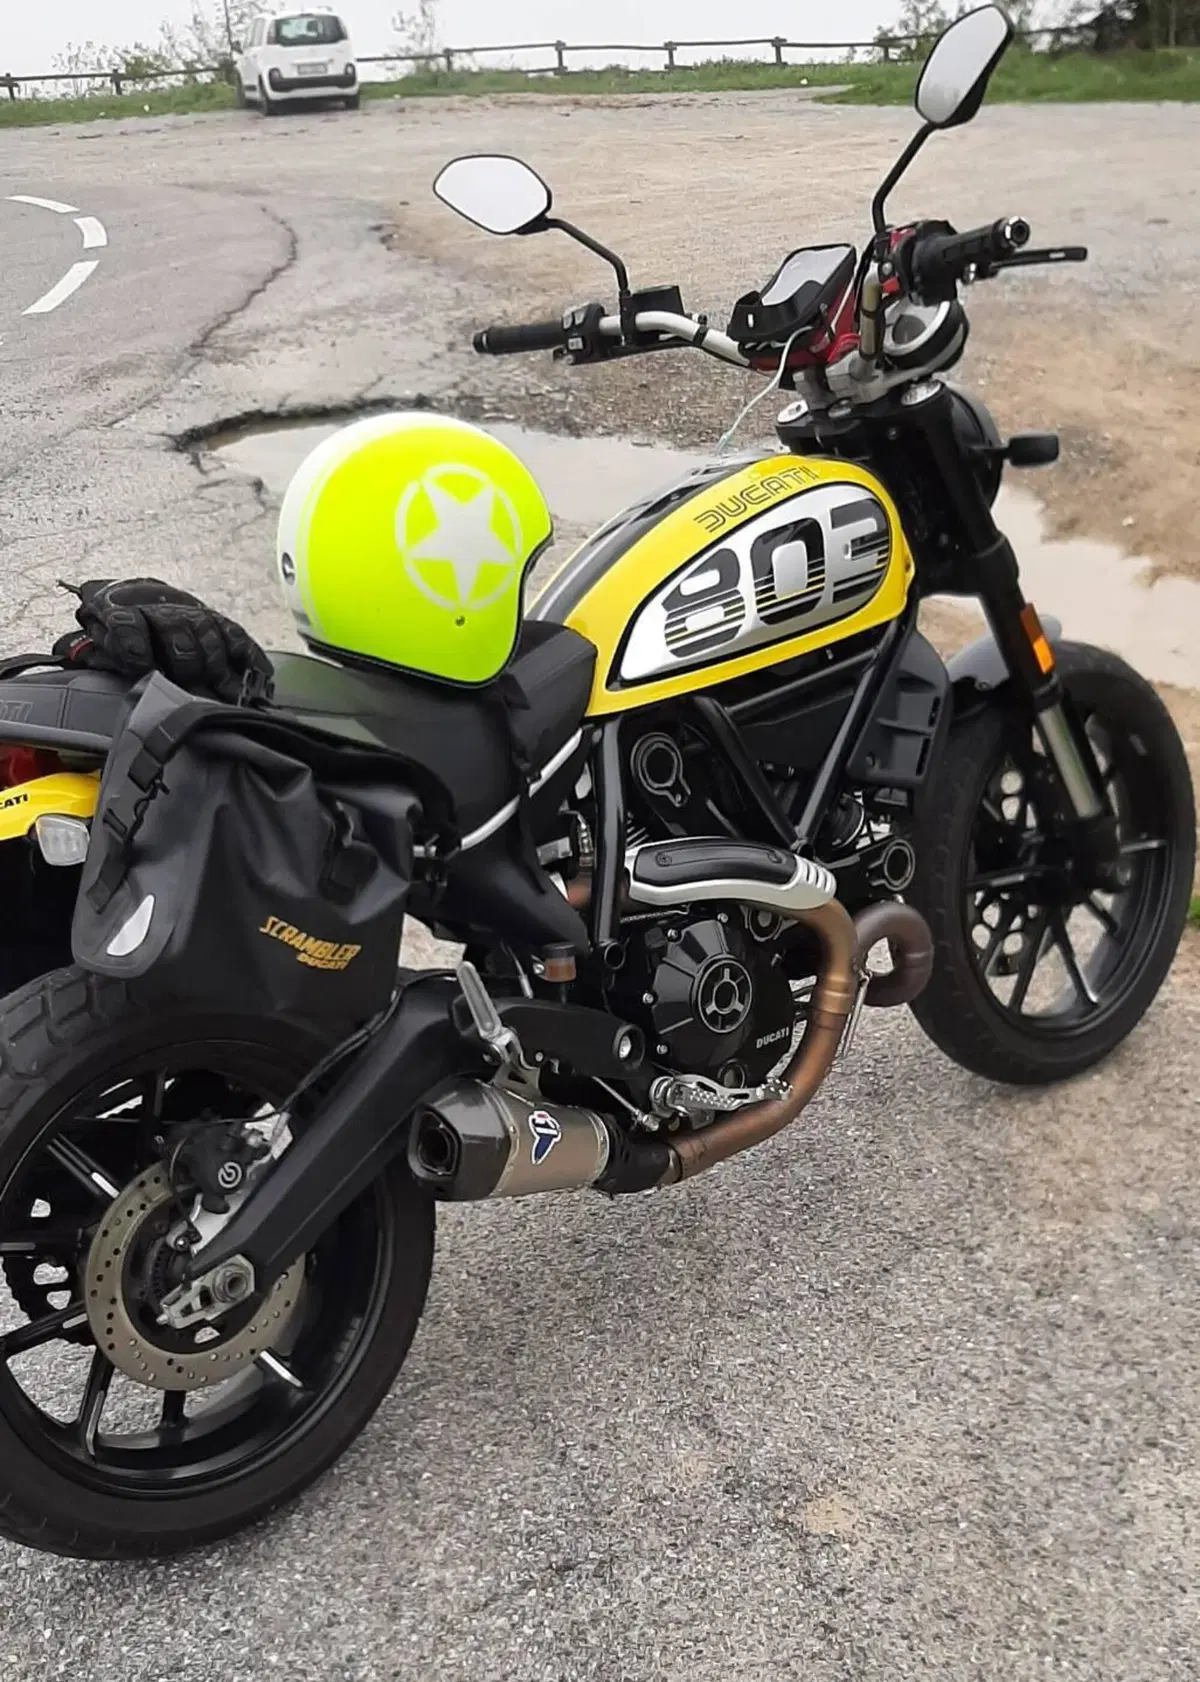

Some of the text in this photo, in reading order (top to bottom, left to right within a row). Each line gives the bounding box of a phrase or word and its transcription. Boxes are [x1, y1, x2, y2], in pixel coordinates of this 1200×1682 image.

[693, 465, 819, 533] DUCATI
[258, 915, 362, 961] SCRAMBLER
[756, 1026, 790, 1049] DUCATI
